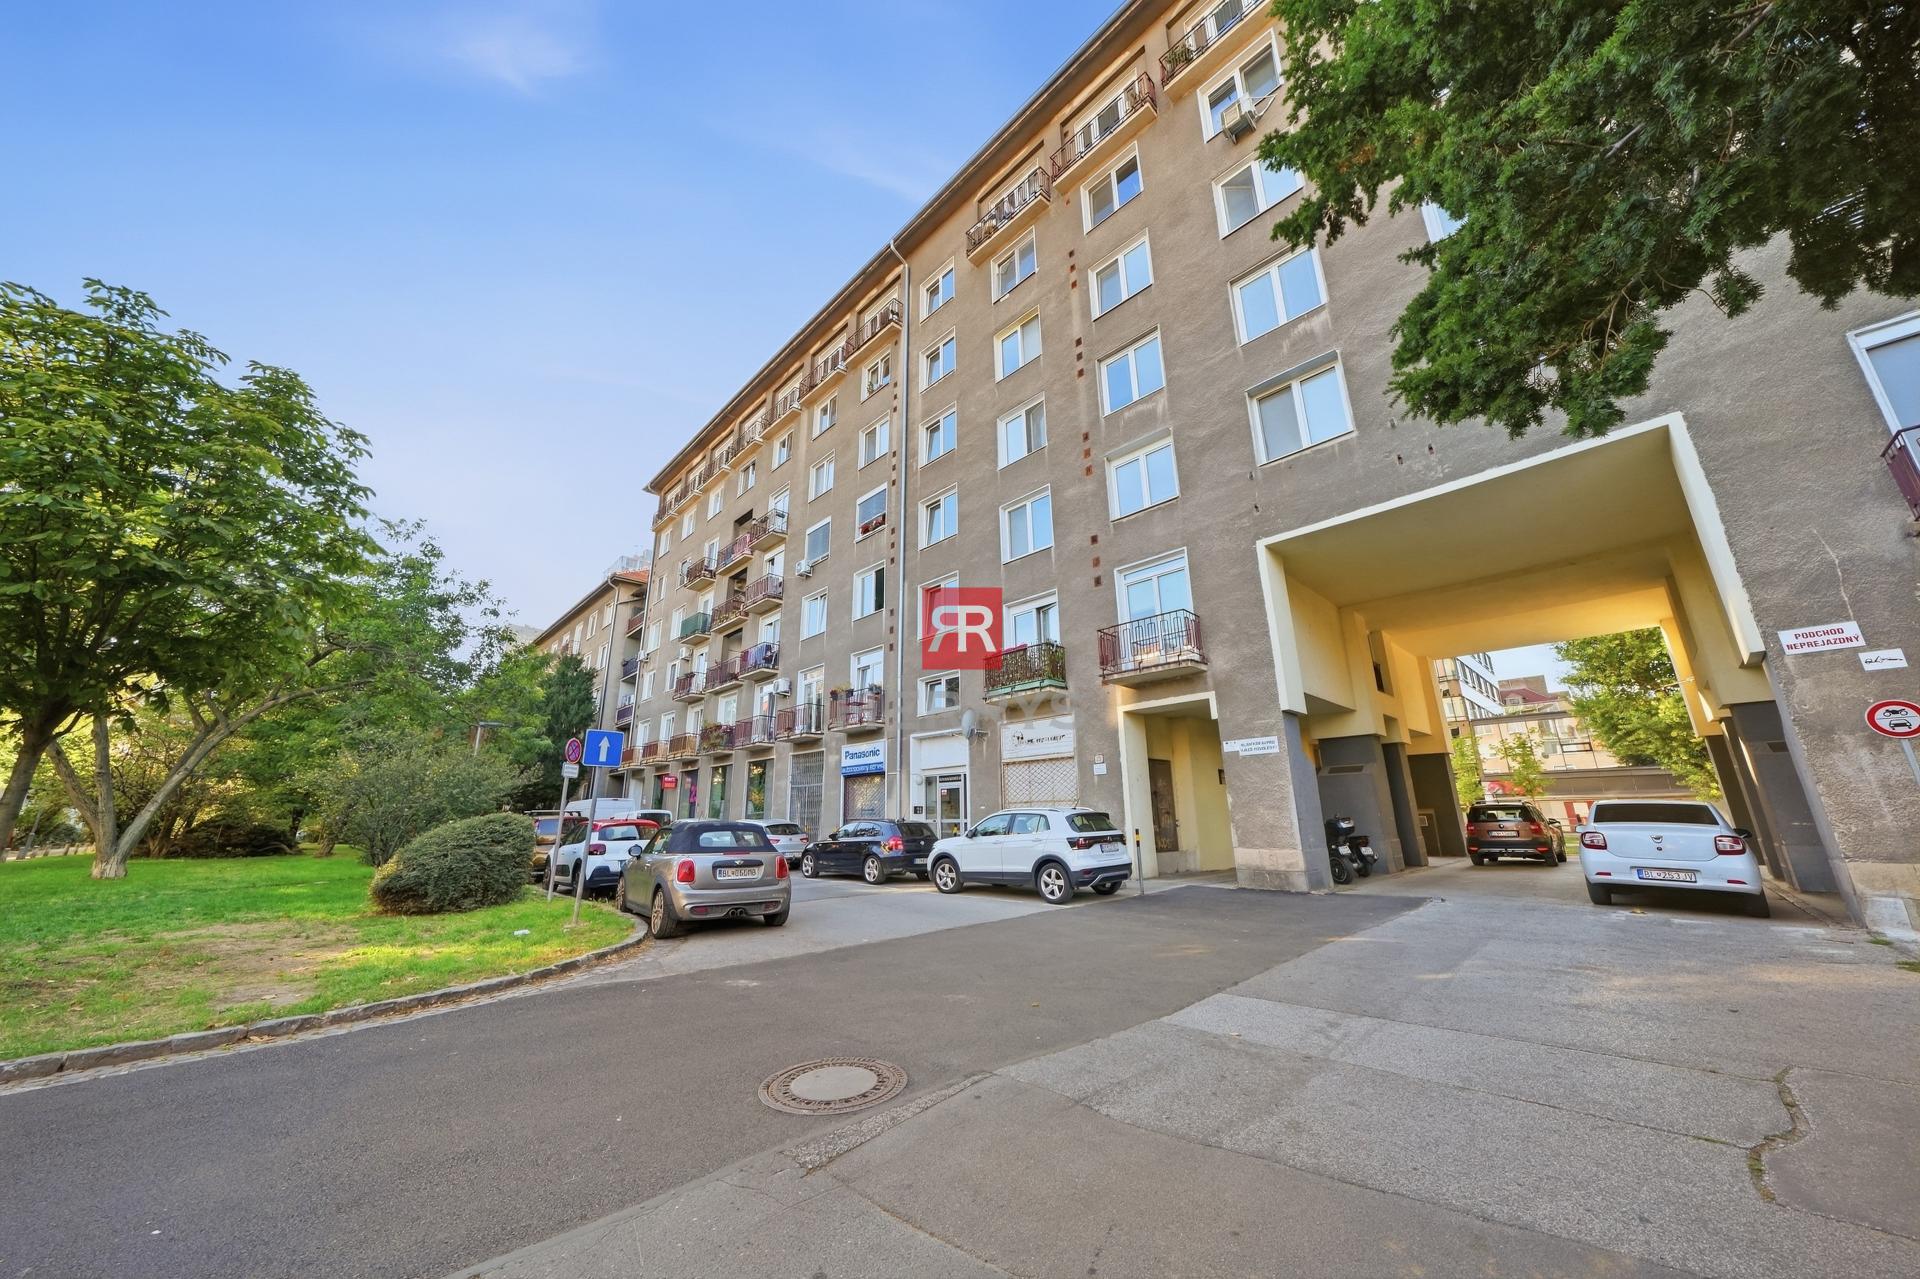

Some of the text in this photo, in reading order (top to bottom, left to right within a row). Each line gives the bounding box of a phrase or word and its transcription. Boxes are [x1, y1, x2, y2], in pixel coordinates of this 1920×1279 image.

[1794, 627, 1844, 640] PODCHOD
[1786, 634, 1860, 650] NEPREJAZDNÝ
[844, 747, 881, 760] Panasonic
